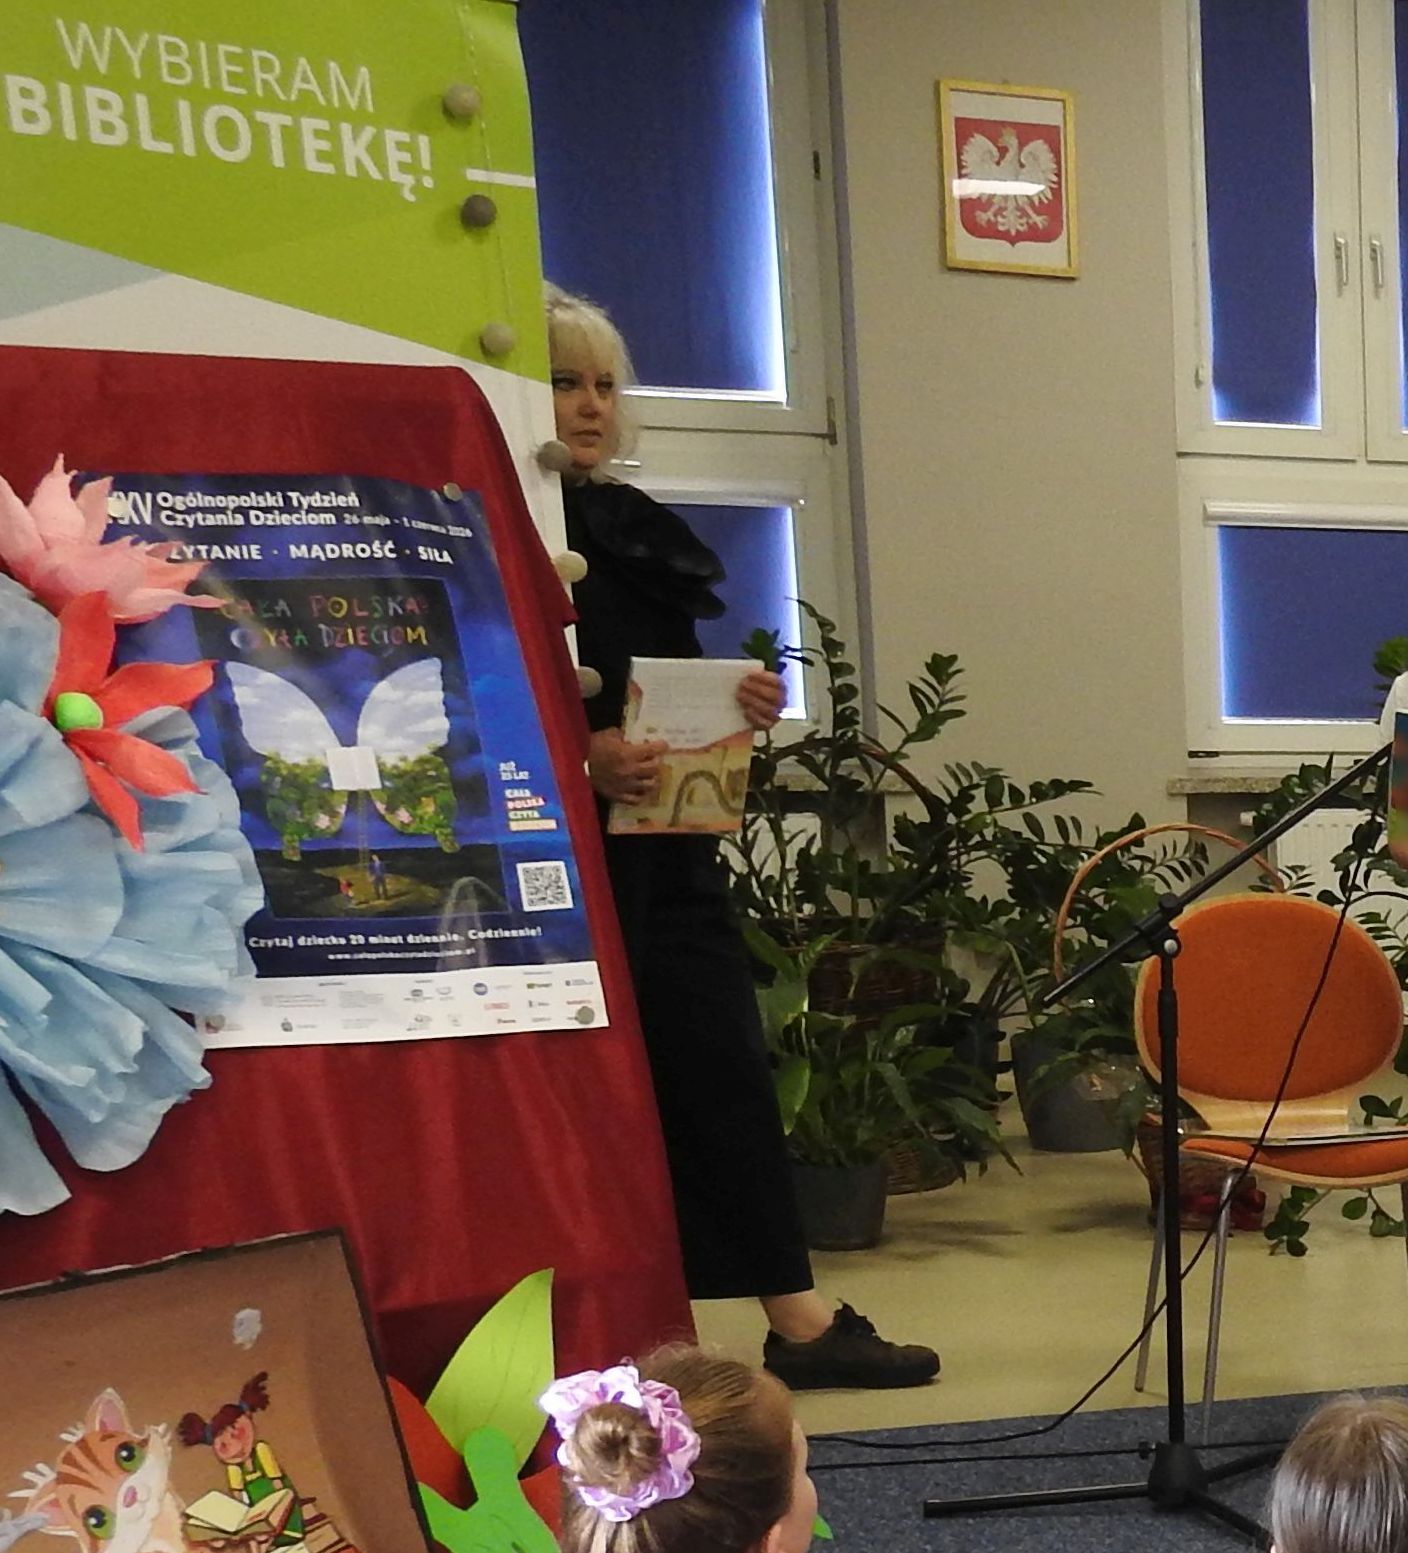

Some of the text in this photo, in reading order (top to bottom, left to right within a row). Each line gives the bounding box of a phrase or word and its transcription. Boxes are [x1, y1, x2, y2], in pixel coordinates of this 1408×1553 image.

[56, 17, 374, 113] WYBIERAM
[4, 73, 434, 202] BIBLIOTEKĘ!
[156, 491, 284, 510] Ogólnopolski
[287, 490, 360, 509] Tydzień
[160, 510, 245, 528] Czytania
[249, 510, 337, 526] Dzieciom
[169, 543, 262, 560] ZYTANIE
[289, 540, 397, 561] MĄDROŚĆ
